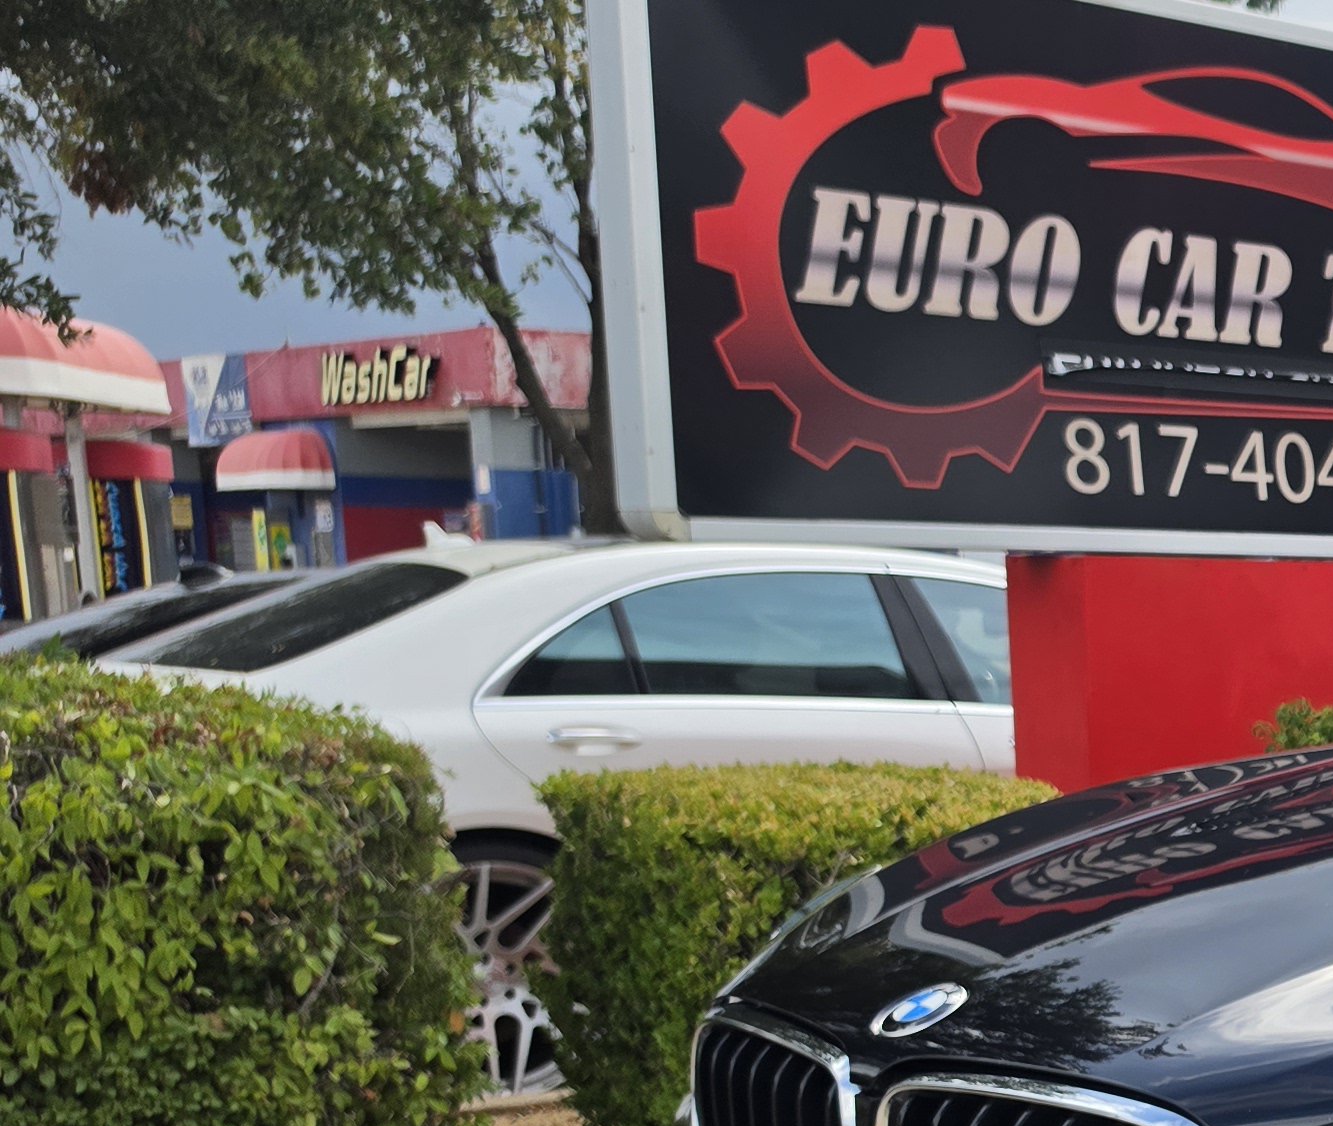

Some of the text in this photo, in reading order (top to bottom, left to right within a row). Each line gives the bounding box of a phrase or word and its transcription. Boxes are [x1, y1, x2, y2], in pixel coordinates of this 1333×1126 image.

[795, 187, 1082, 327] EURO
[1112, 227, 1293, 349] CAR
[321, 343, 431, 407] WashCar
